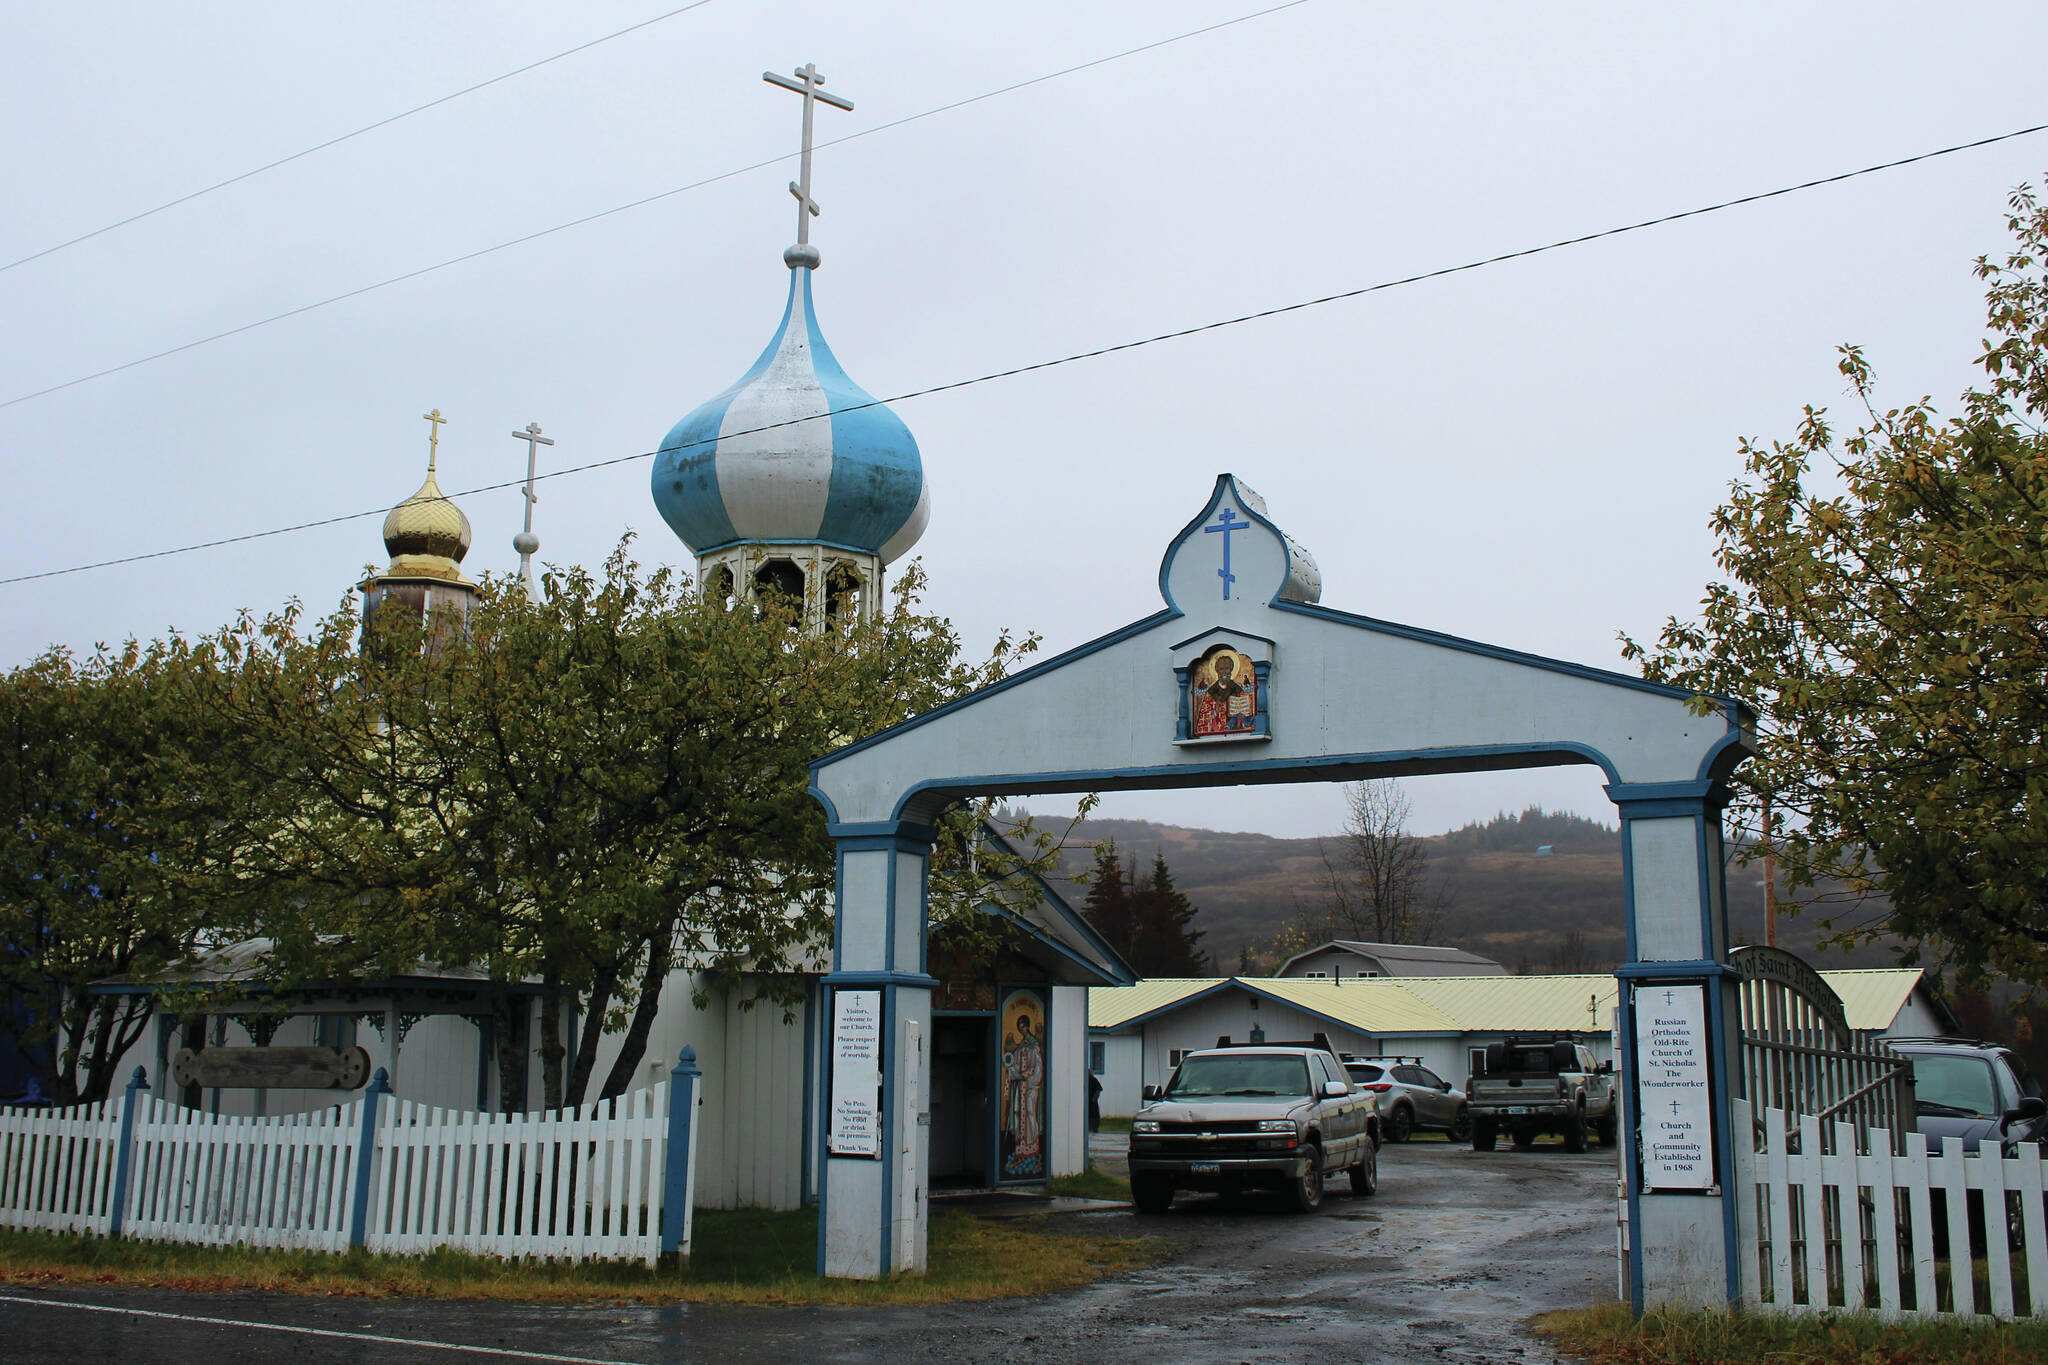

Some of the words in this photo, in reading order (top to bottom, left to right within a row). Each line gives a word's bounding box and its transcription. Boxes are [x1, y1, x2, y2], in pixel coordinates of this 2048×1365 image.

[1744, 949, 1757, 979] of
[1655, 1018, 1687, 1026] Russian
[1651, 1028, 1691, 1036] Orthodox
[1654, 1038, 1689, 1046] Old-Rite
[1651, 1049, 1682, 1057] Church
[1684, 1048, 1693, 1056] of
[1643, 1080, 1705, 1088] Wonderworker
[1660, 1121, 1692, 1129] Church
[1668, 1132, 1684, 1140] and
[1653, 1143, 1701, 1152] Community
[1654, 1153, 1701, 1161] Established
